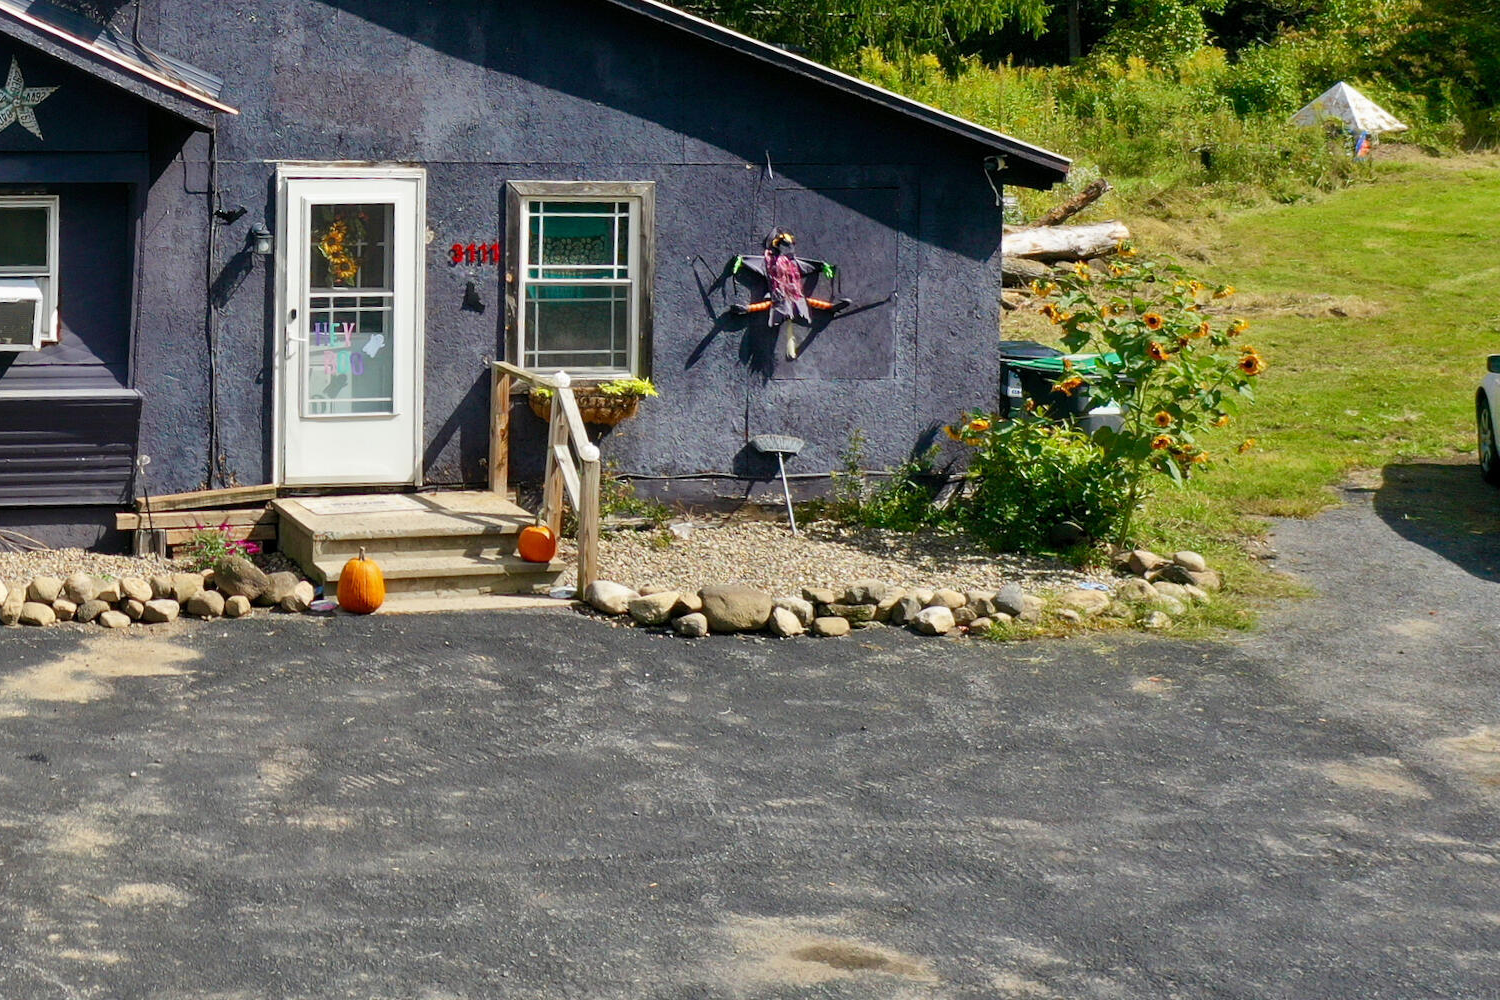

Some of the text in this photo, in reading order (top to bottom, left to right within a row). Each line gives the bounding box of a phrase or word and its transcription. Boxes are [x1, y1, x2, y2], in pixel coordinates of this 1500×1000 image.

[451, 242, 500, 263] 3111
[314, 322, 355, 347] HEY
[323, 350, 364, 376] BOO
